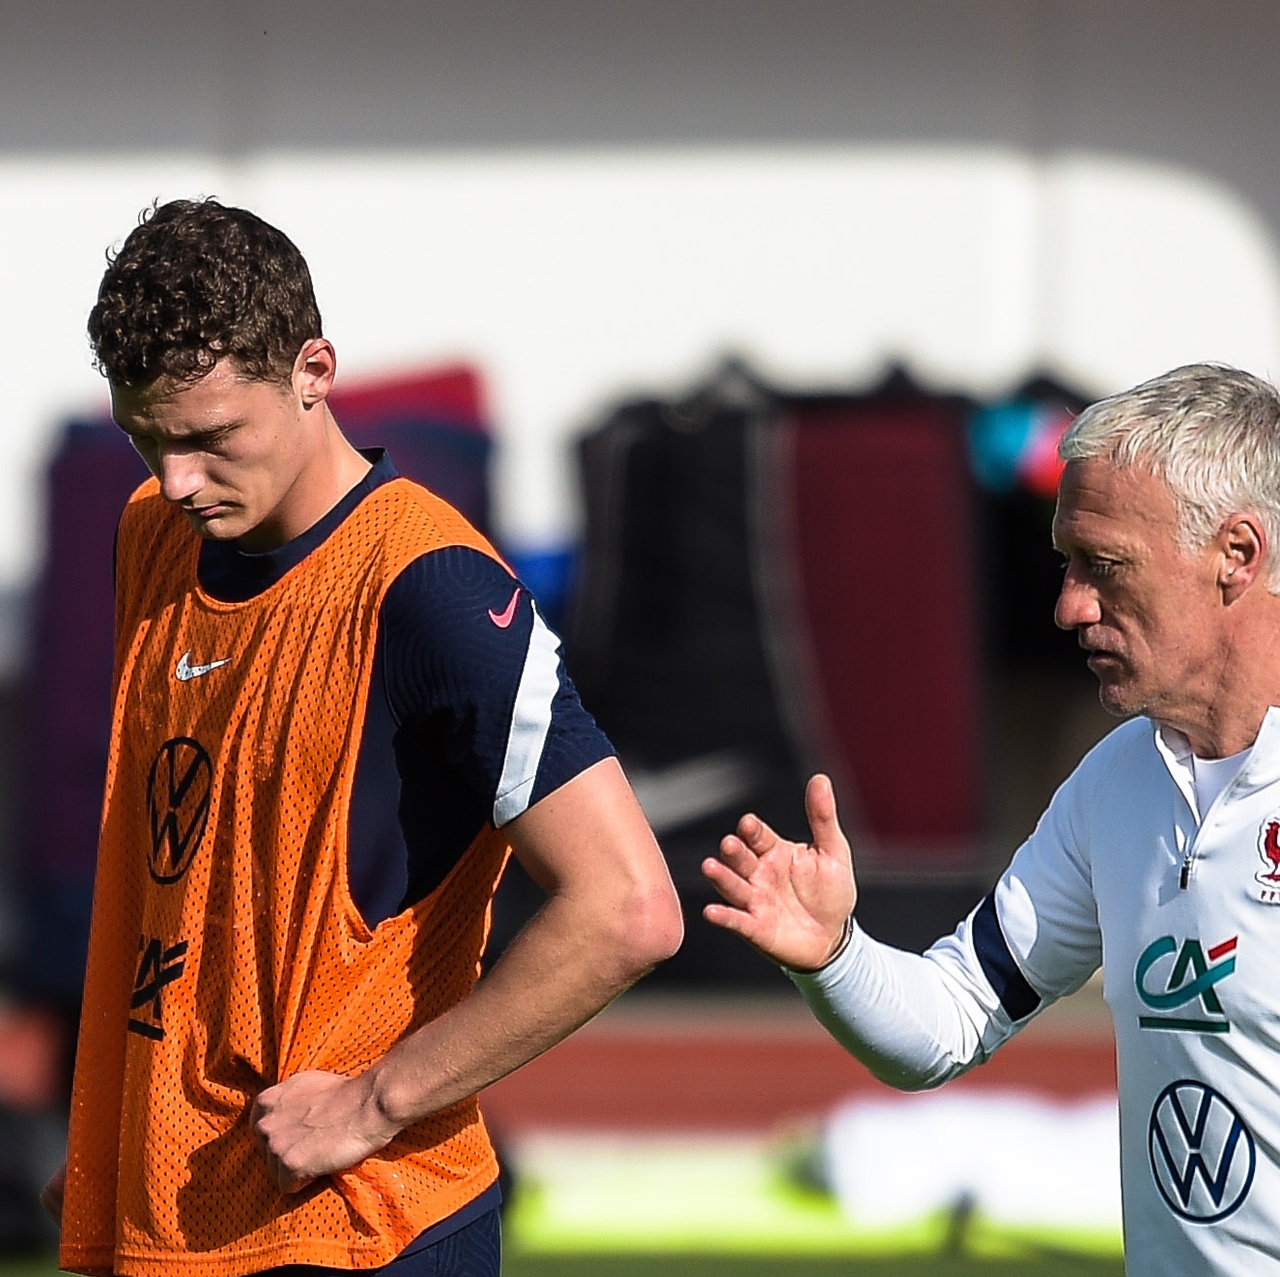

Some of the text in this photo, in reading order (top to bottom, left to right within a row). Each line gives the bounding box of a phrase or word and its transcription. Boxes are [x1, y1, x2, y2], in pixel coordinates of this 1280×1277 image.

[149, 740, 211, 880] VW
[1135, 934, 1238, 1016] CA
[1150, 1083, 1250, 1214] VW
